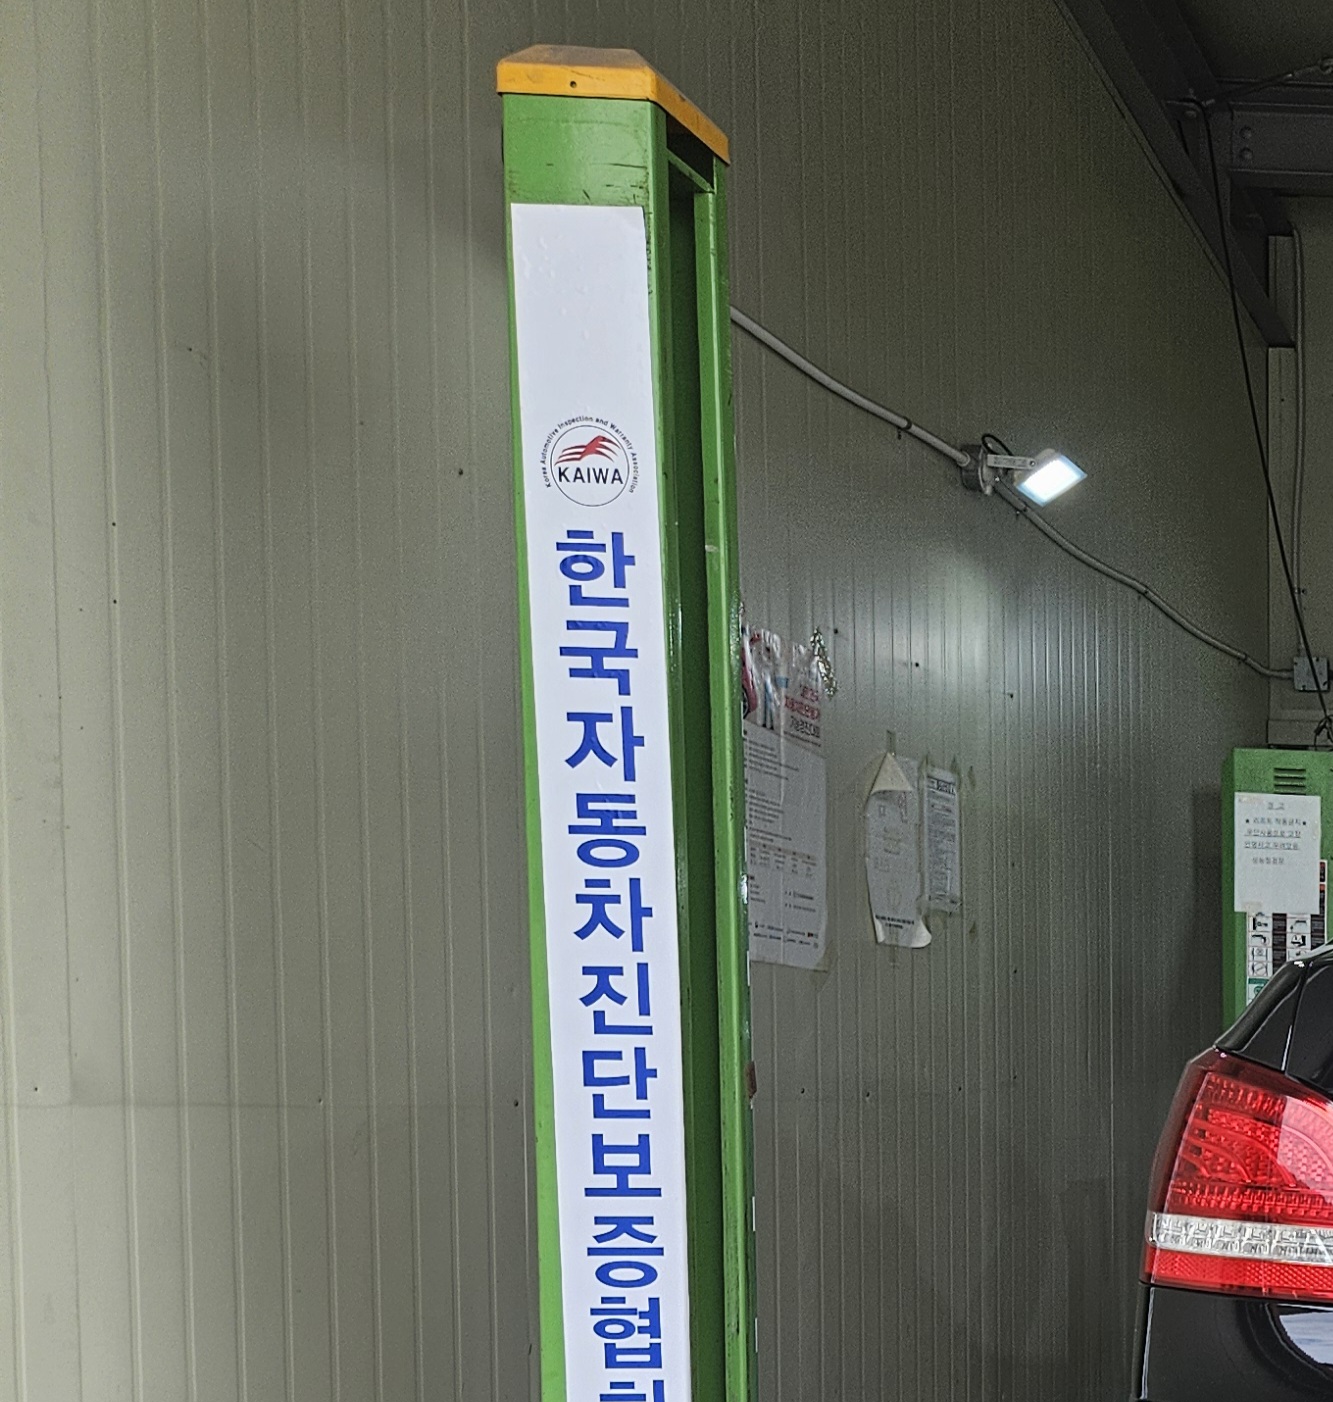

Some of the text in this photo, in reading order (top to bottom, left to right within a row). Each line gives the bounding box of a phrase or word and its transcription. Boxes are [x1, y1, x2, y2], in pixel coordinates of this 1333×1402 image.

[540, 429, 559, 465] Automotive
[557, 415, 594, 430] Inspection
[595, 417, 609, 426] and
[610, 423, 634, 450] Warranty
[629, 452, 640, 494] Association
[558, 466, 624, 485] KAIWA
